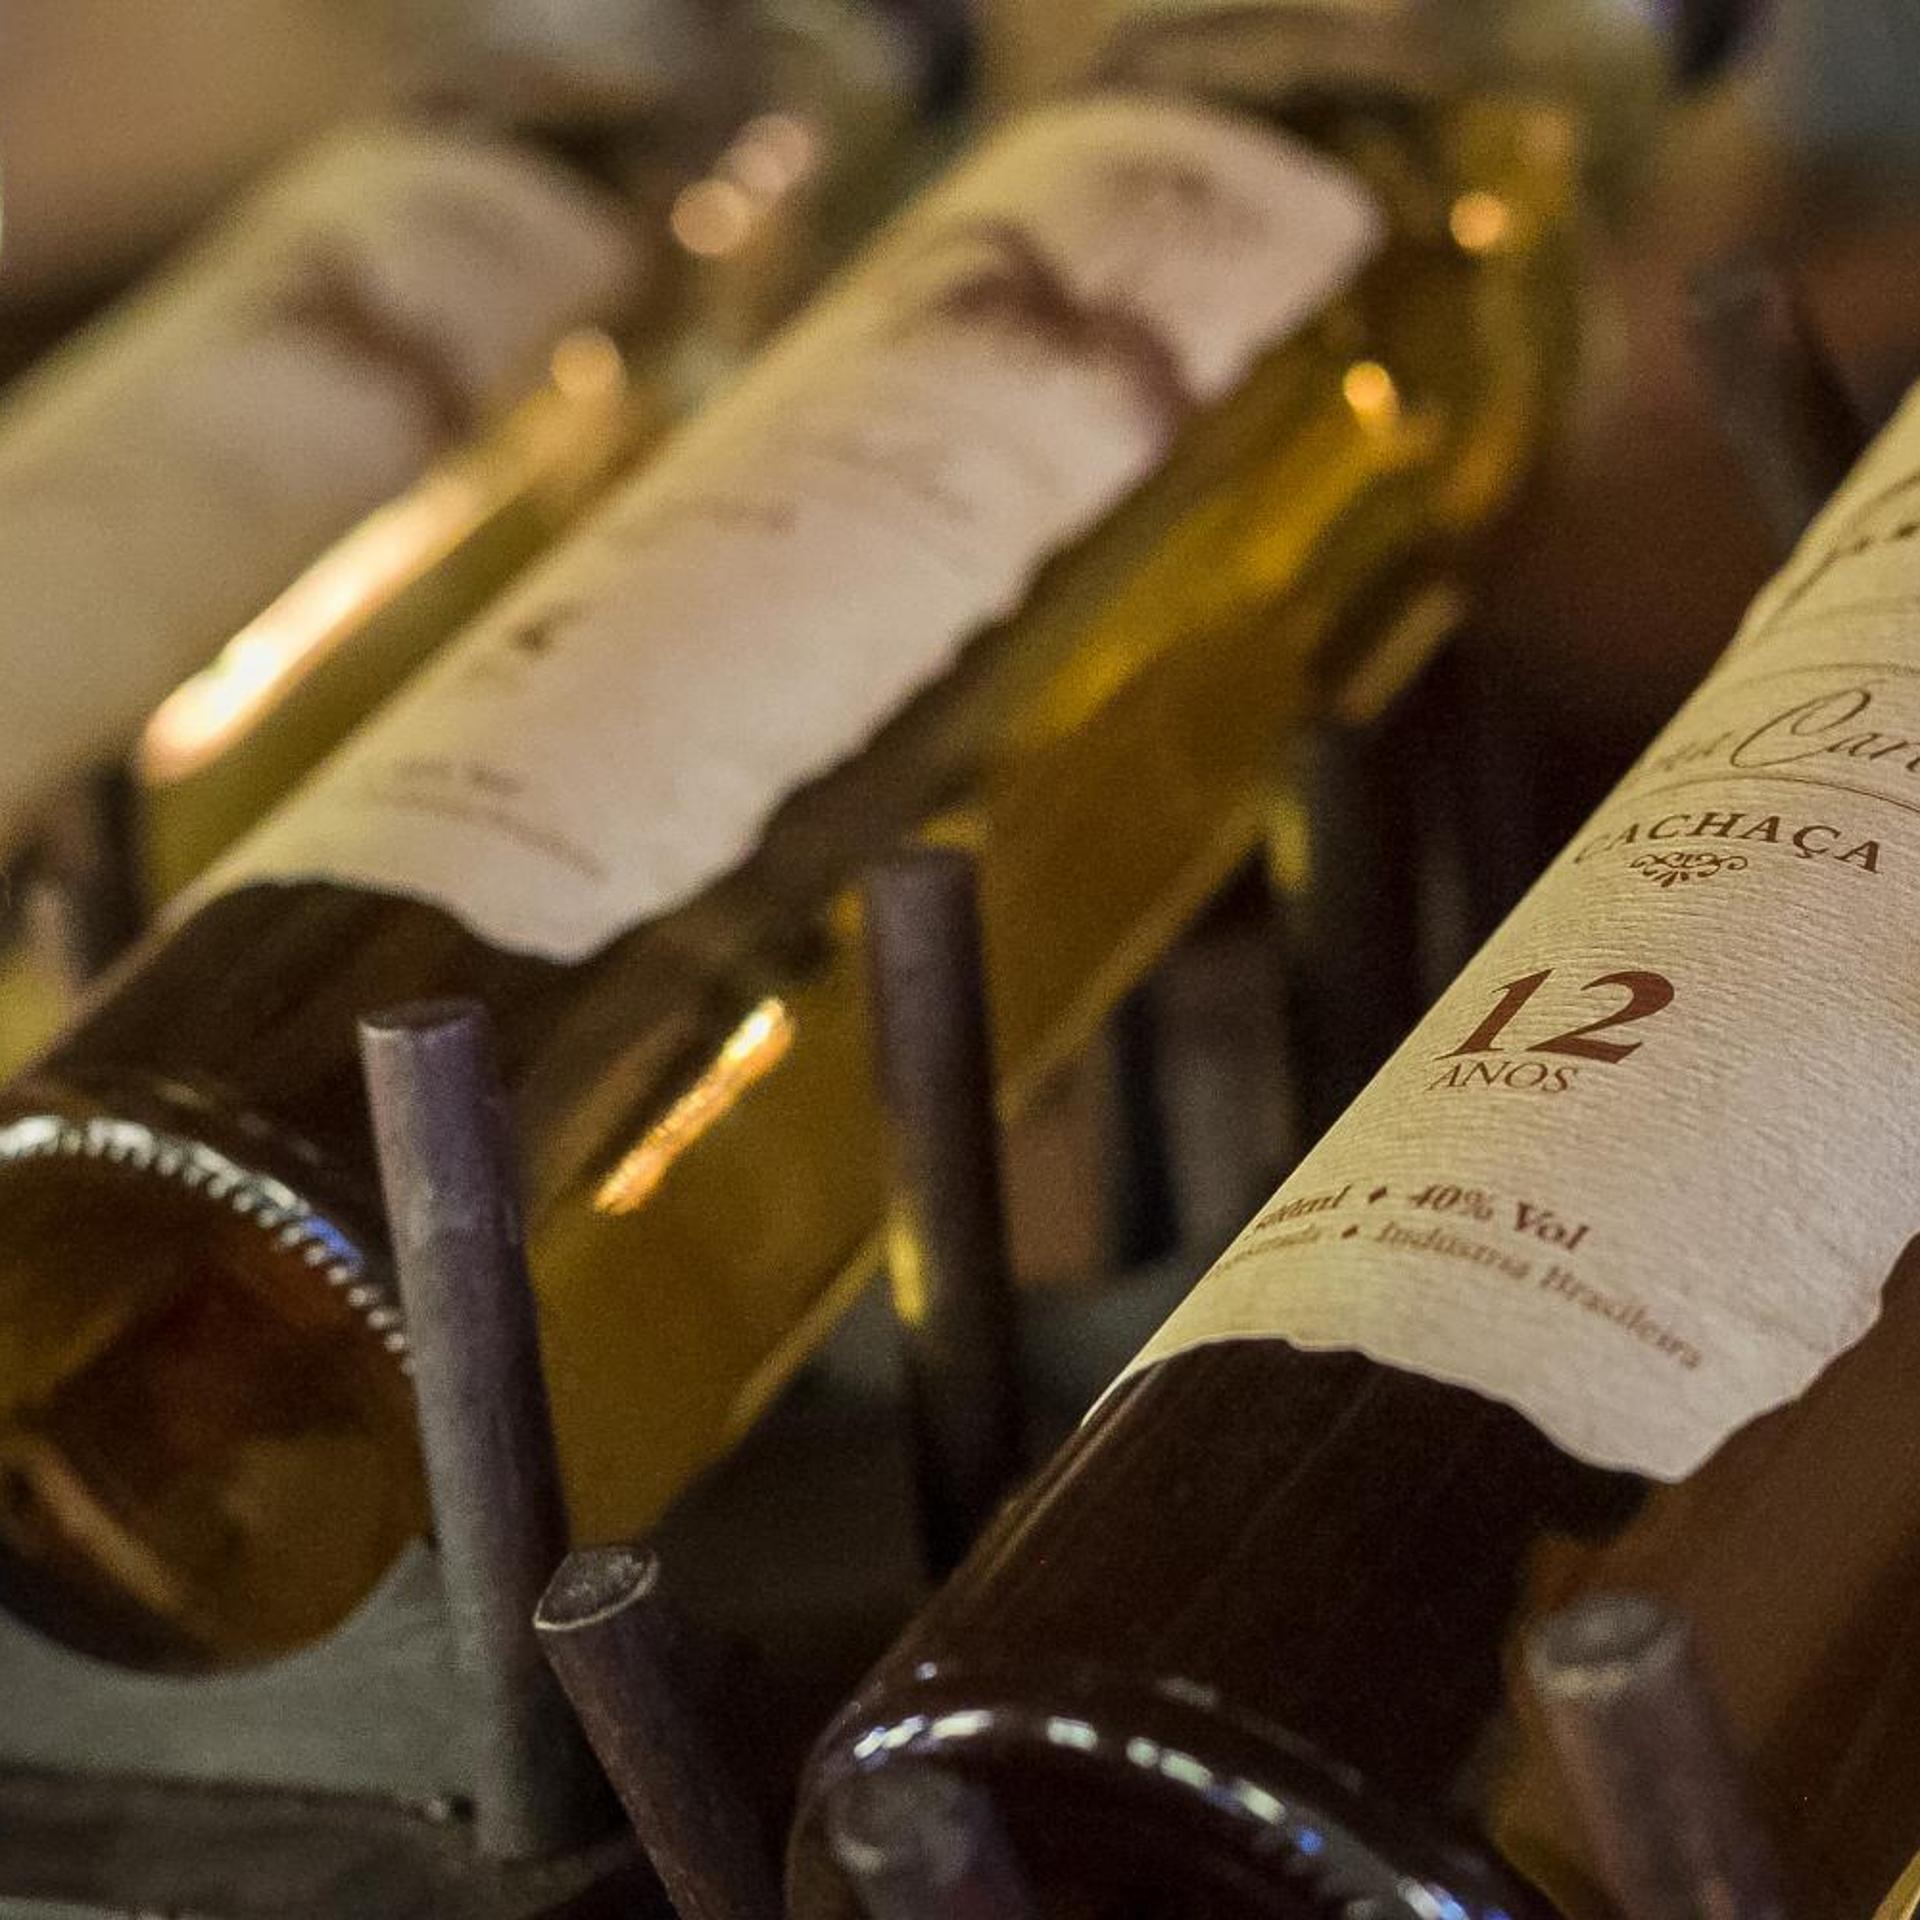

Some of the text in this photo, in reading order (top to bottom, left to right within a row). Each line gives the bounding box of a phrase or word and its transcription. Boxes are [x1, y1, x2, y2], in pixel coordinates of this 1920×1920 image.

[1573, 811, 1884, 874] CACHAÇA
[1433, 967, 1676, 1064] 12
[1421, 1059, 1579, 1093] ANOS
[1407, 1183, 1495, 1222] 40%
[1513, 1201, 1590, 1250] Vol
